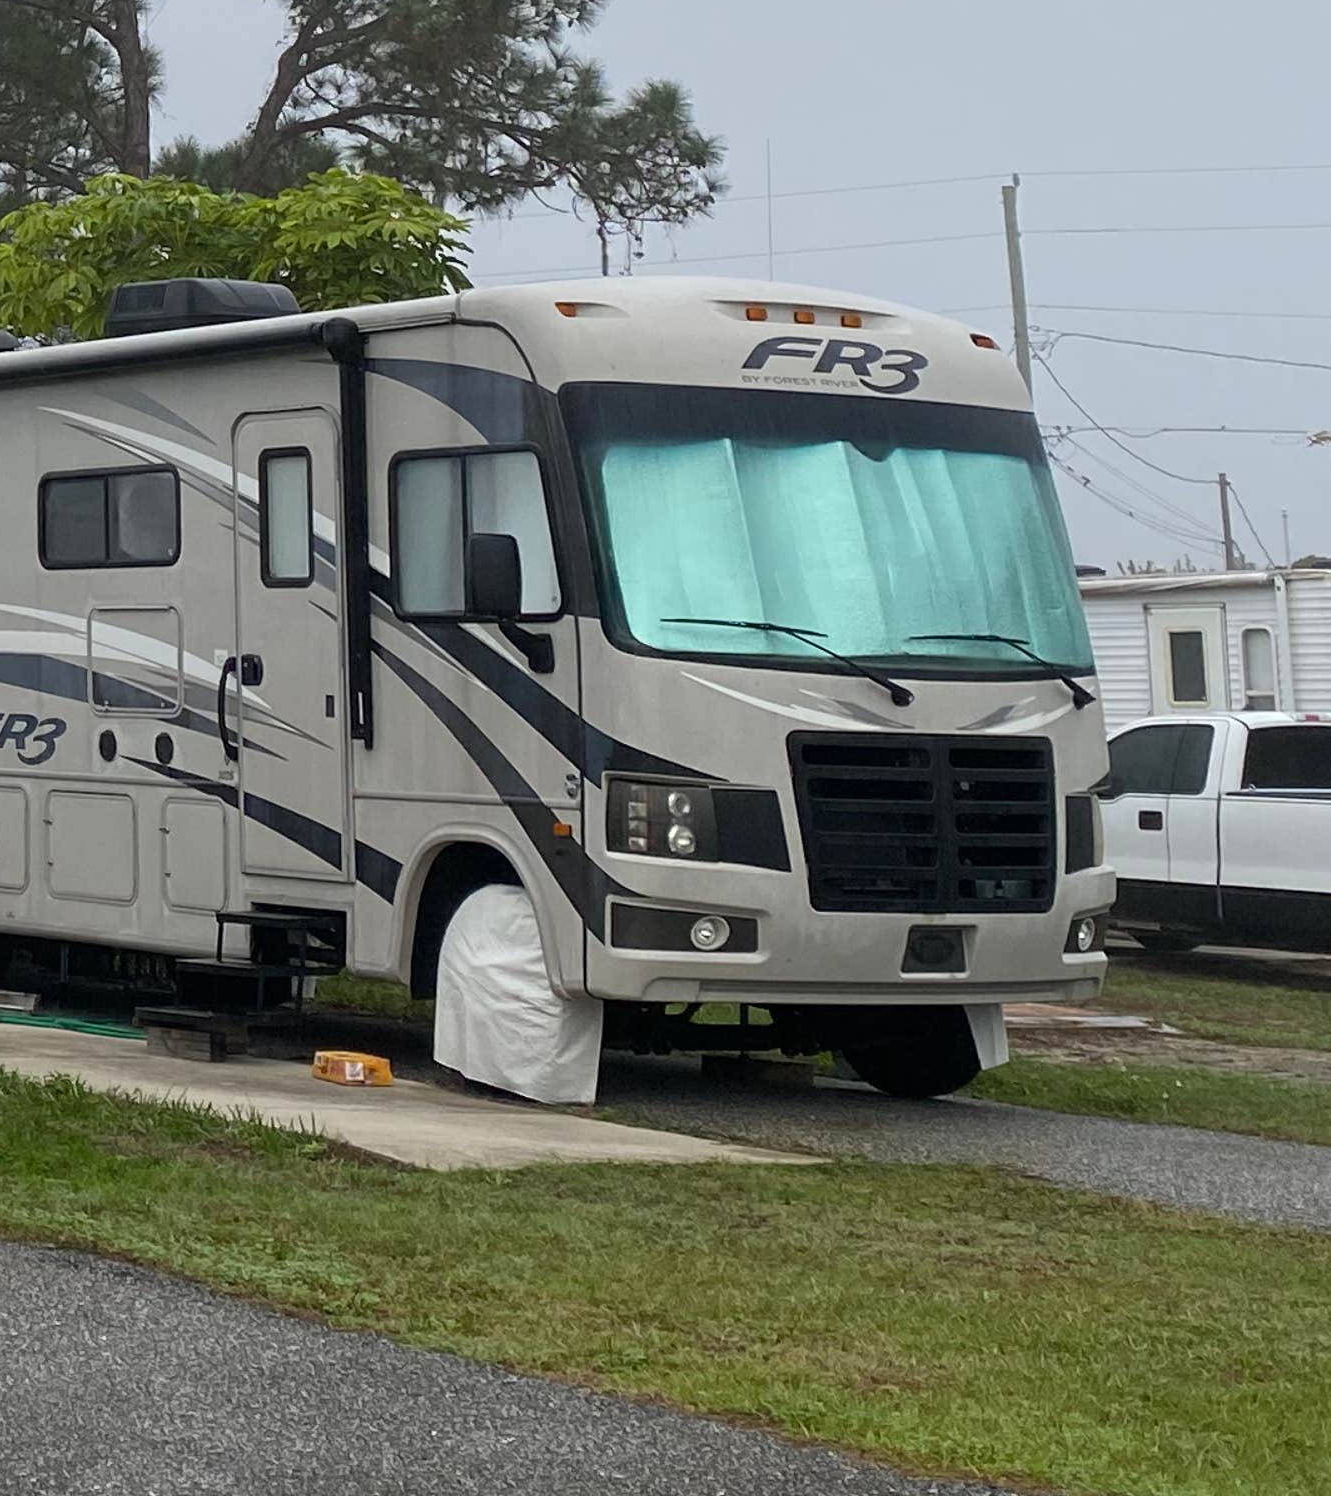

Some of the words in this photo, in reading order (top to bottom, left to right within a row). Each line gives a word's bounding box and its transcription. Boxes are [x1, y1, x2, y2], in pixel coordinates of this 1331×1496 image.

[741, 336, 929, 394] FR3
[763, 376, 817, 386] FOREST
[819, 379, 859, 388] RIVER
